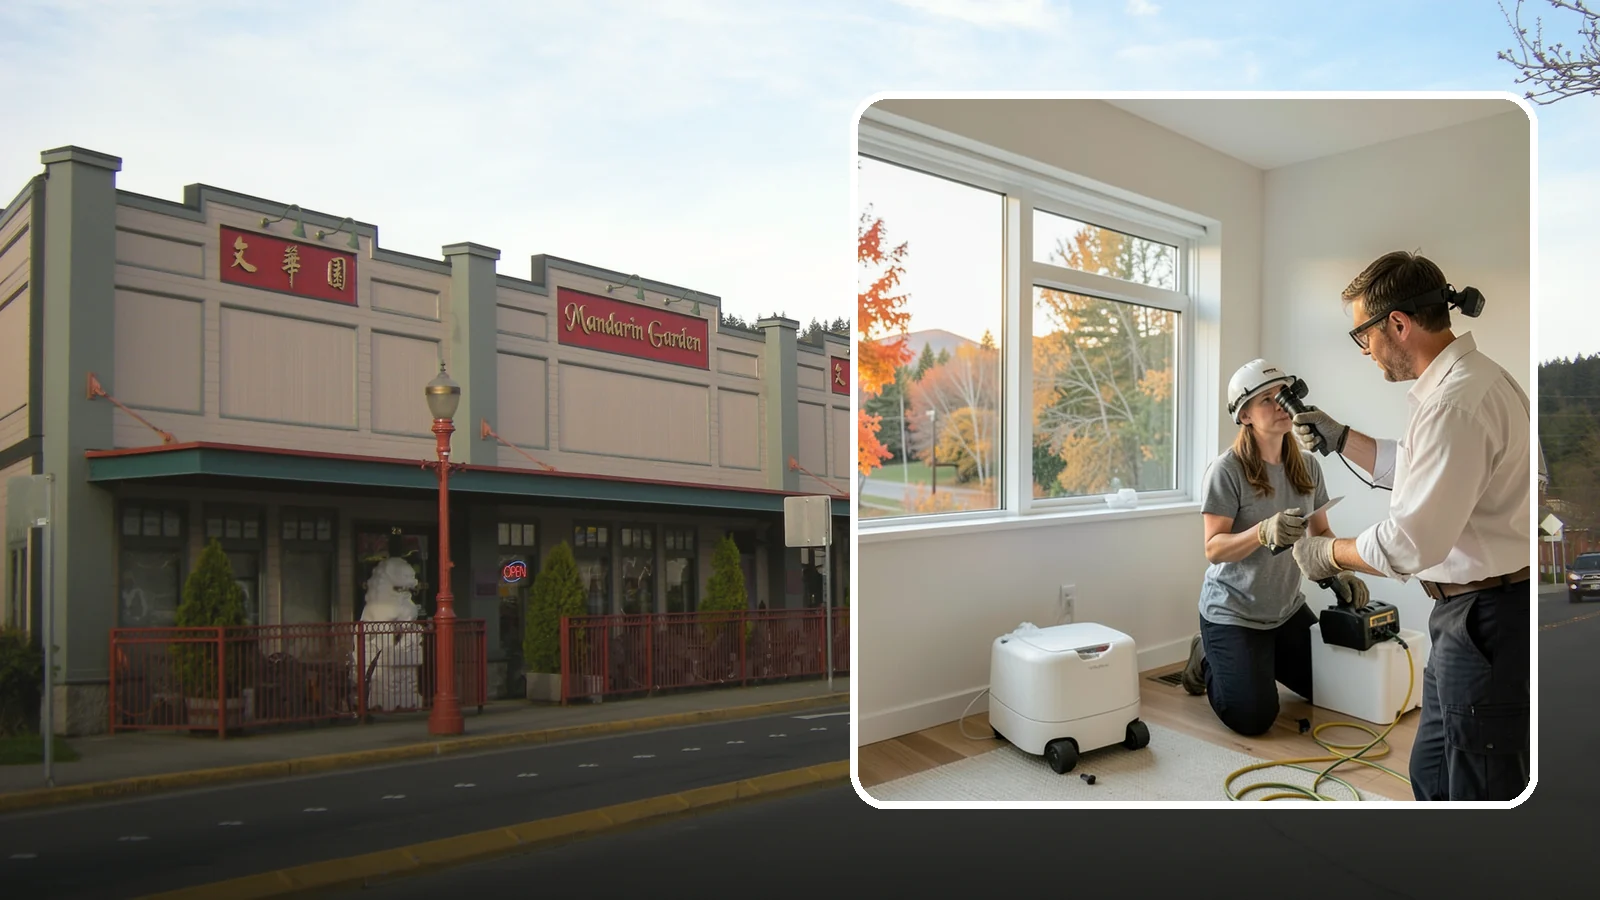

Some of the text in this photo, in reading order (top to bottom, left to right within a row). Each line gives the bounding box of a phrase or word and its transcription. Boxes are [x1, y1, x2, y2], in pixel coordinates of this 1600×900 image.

[564, 302, 701, 352] Mandarin Garden
[503, 565, 527, 578] OPEN
